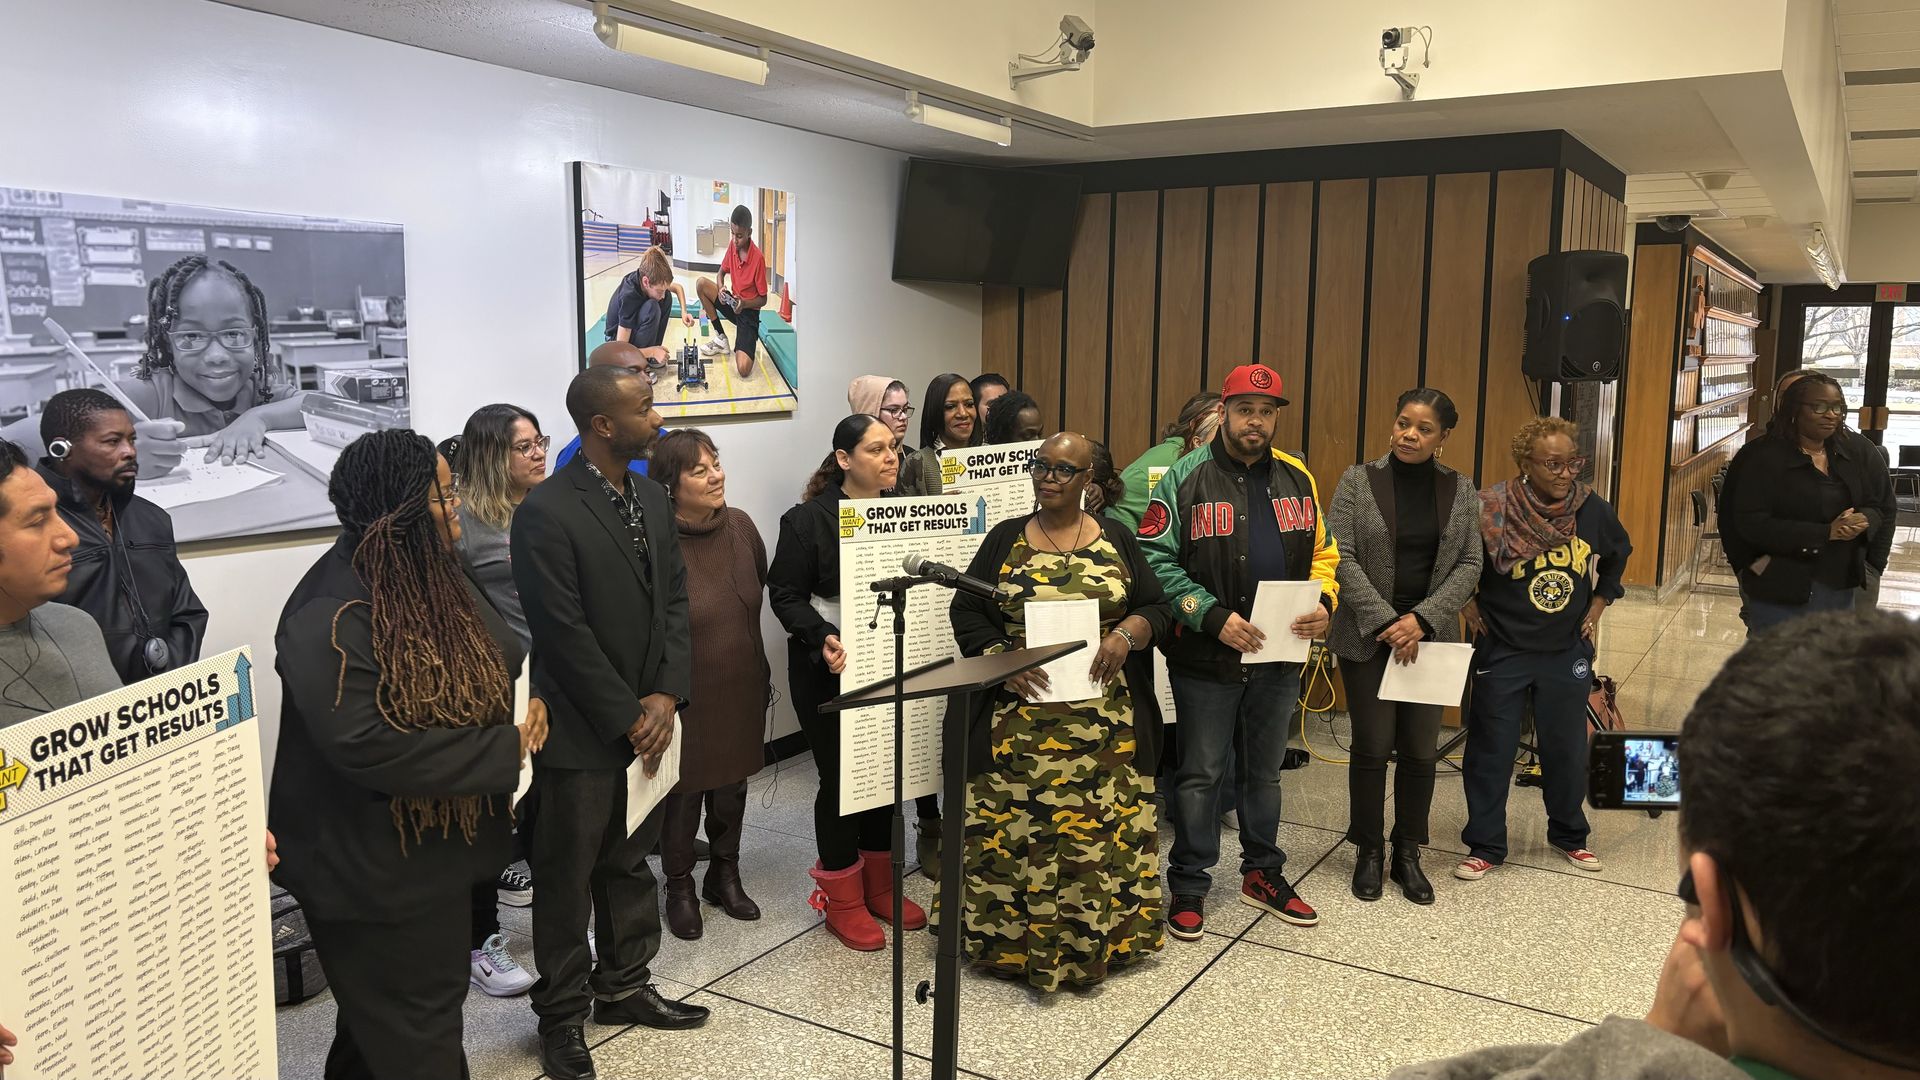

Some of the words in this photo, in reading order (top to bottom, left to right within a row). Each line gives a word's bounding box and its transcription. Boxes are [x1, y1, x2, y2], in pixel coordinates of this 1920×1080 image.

[967, 452, 1005, 467] GROW
[968, 467, 996, 480] THAT
[999, 464, 1019, 476] GET
[842, 508, 852, 516] WE
[866, 506, 907, 521] GROW
[910, 503, 968, 518] SCHOOLS
[867, 522, 897, 535] THAT
[900, 520, 920, 533] GET
[924, 517, 969, 531] RESULTS
[30, 712, 110, 763] GROW
[116, 673, 221, 731] SCHOOLS
[34, 750, 95, 792] THAT
[100, 732, 139, 765] GET
[146, 700, 224, 748] RESULTS
